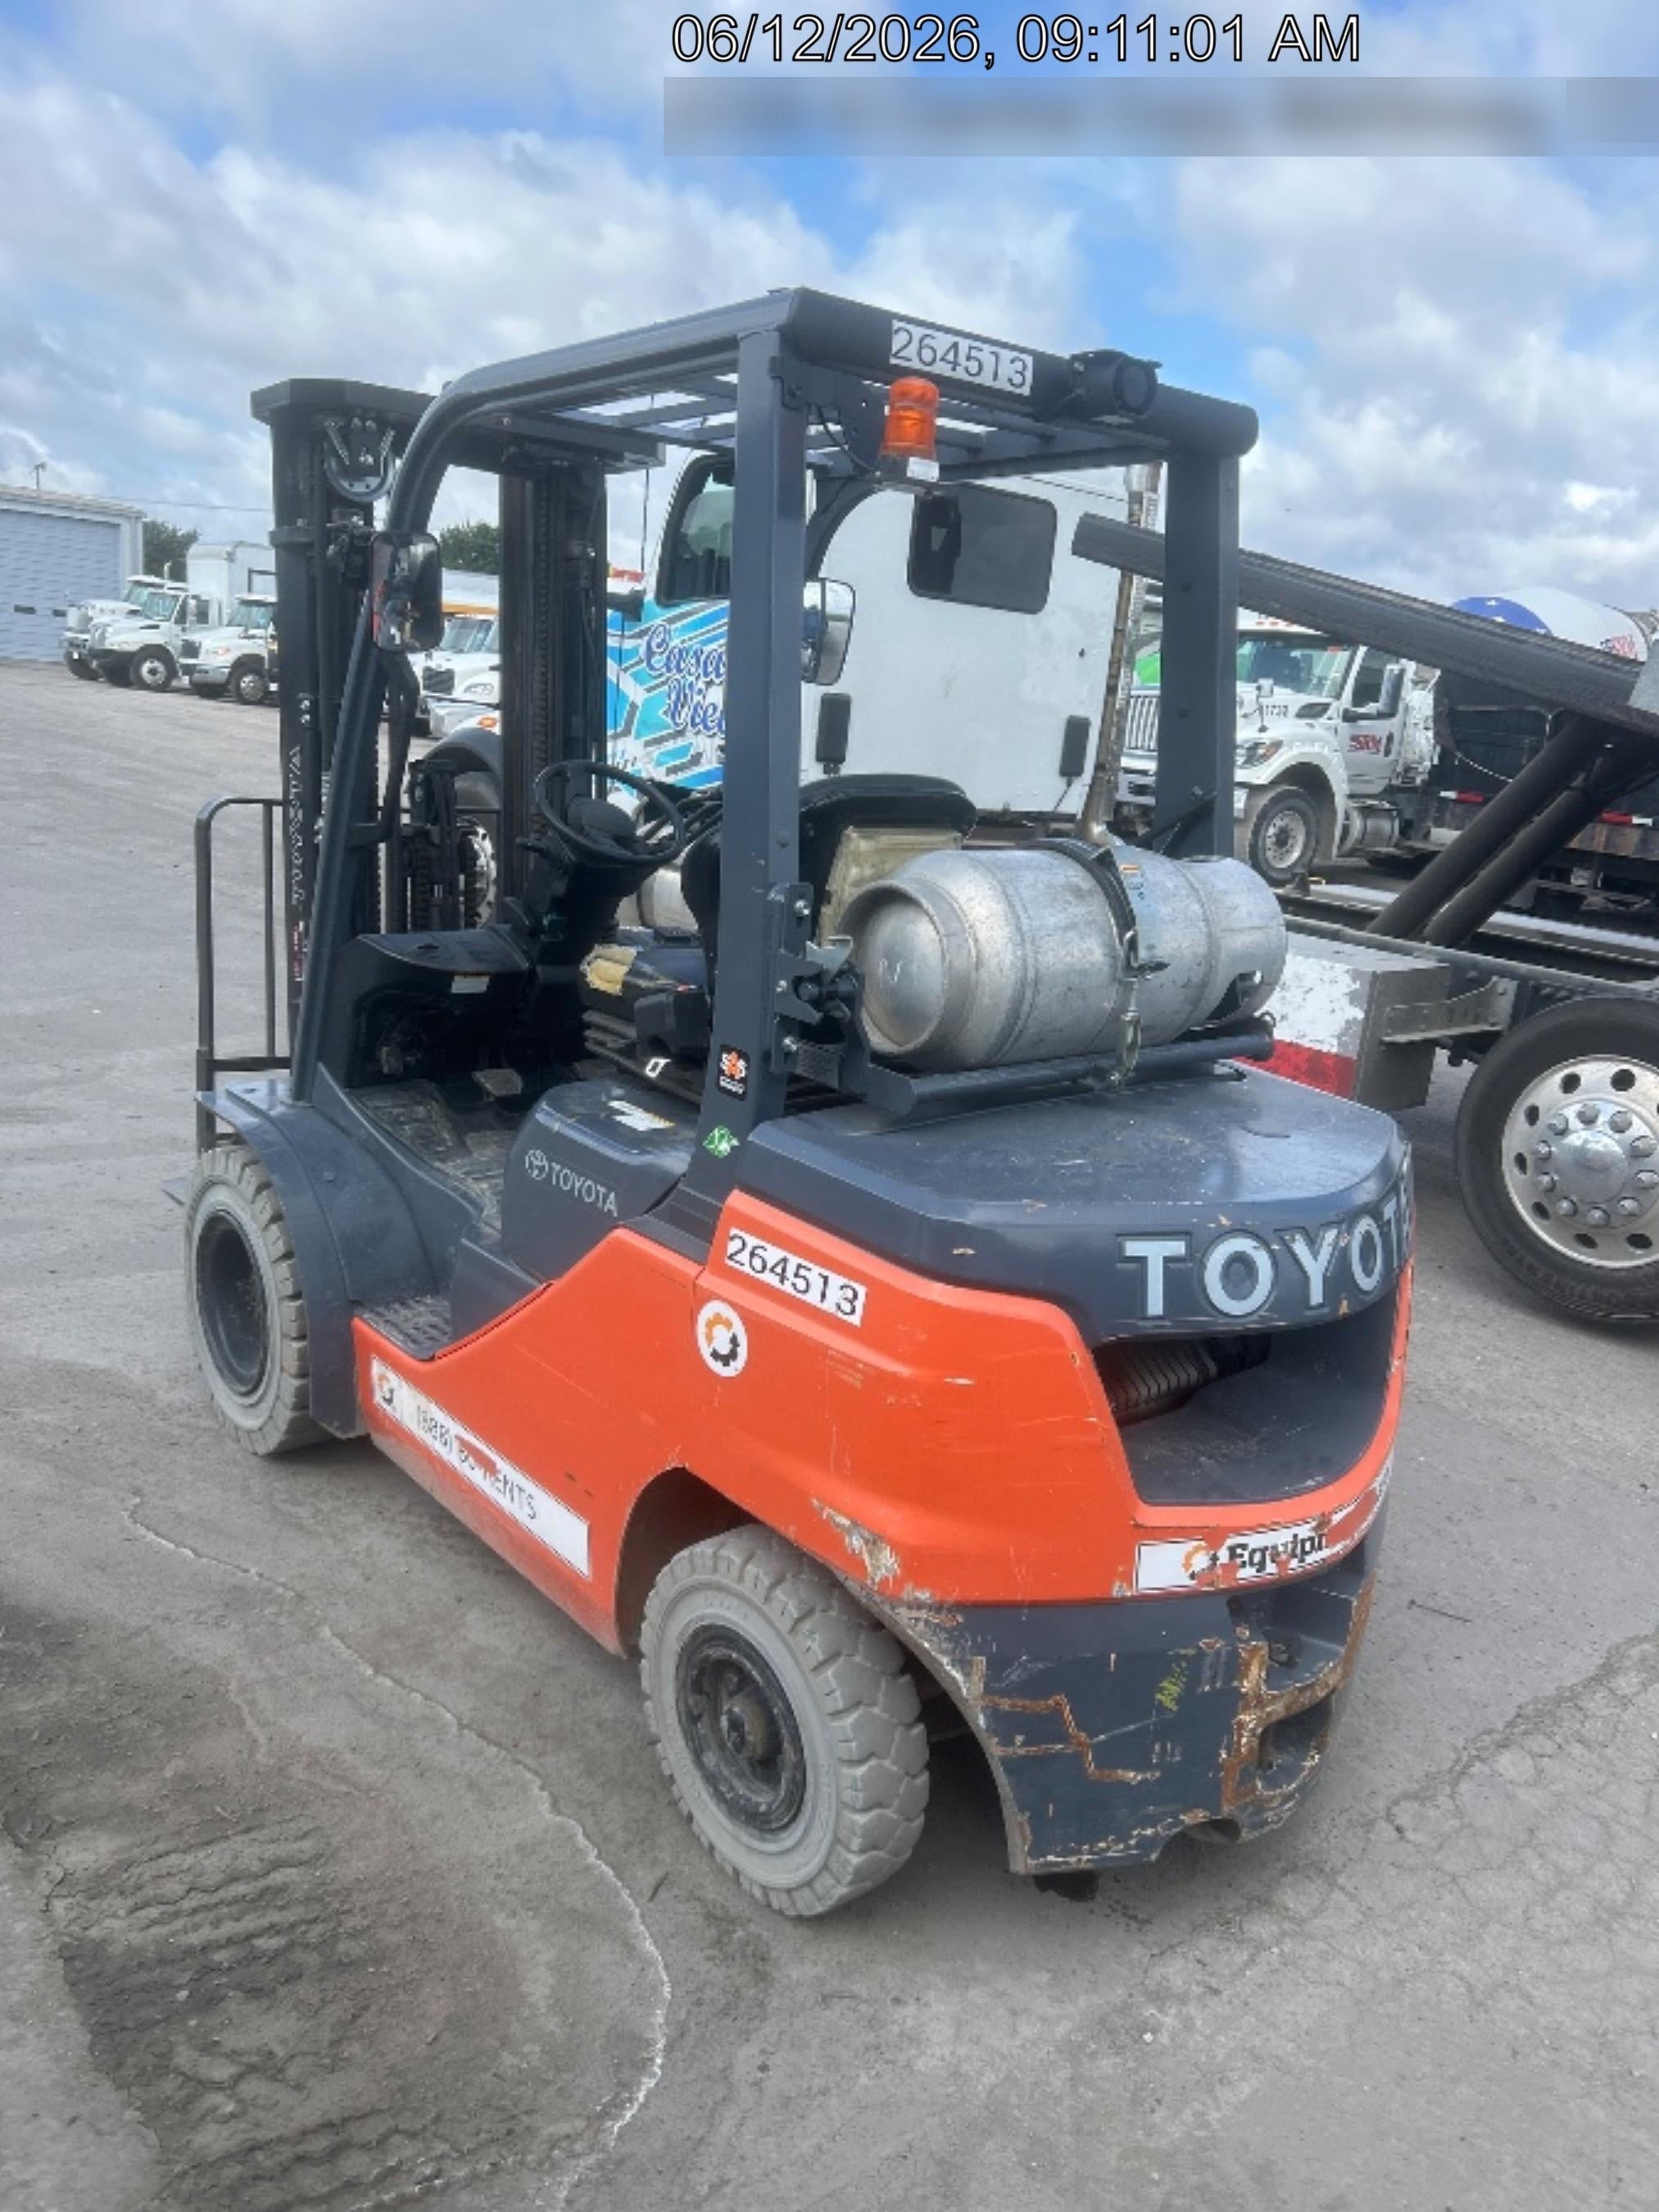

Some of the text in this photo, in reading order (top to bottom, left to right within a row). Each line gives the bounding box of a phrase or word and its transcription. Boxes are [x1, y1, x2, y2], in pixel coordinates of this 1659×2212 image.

[891, 326, 1029, 388] 264513
[668, 677, 727, 734] Vie
[551, 1162, 619, 1217] TOYOTA
[727, 1234, 858, 1316] 264513
[1124, 1185, 1409, 1317] TOYOT
